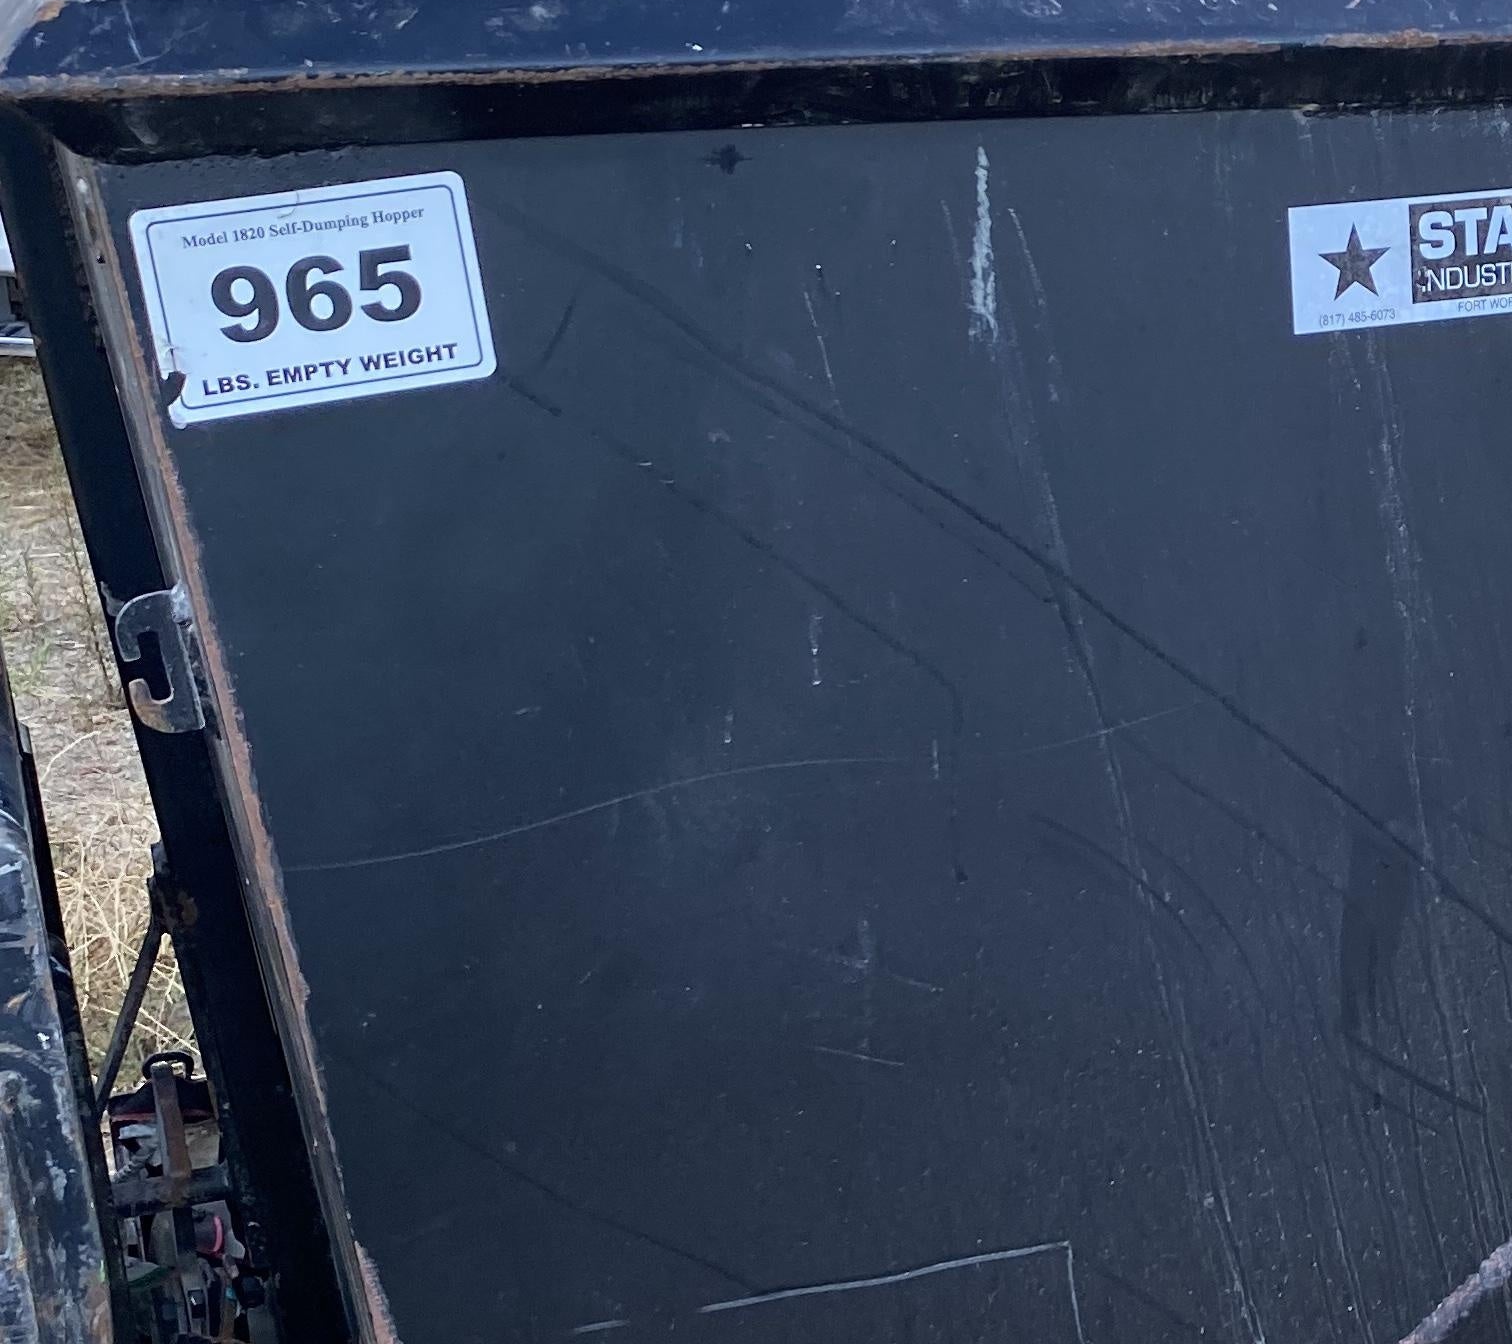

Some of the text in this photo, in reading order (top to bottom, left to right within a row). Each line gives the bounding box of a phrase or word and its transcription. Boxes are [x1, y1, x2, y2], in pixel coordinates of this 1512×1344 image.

[182, 207, 425, 249] Model 1820 Self-Dumping Hopper
[211, 244, 422, 343] 965
[1457, 299, 1487, 313] FORT
[1318, 312, 1346, 328] (817)
[202, 343, 459, 396] LBS. EMPTY WEIGHT
